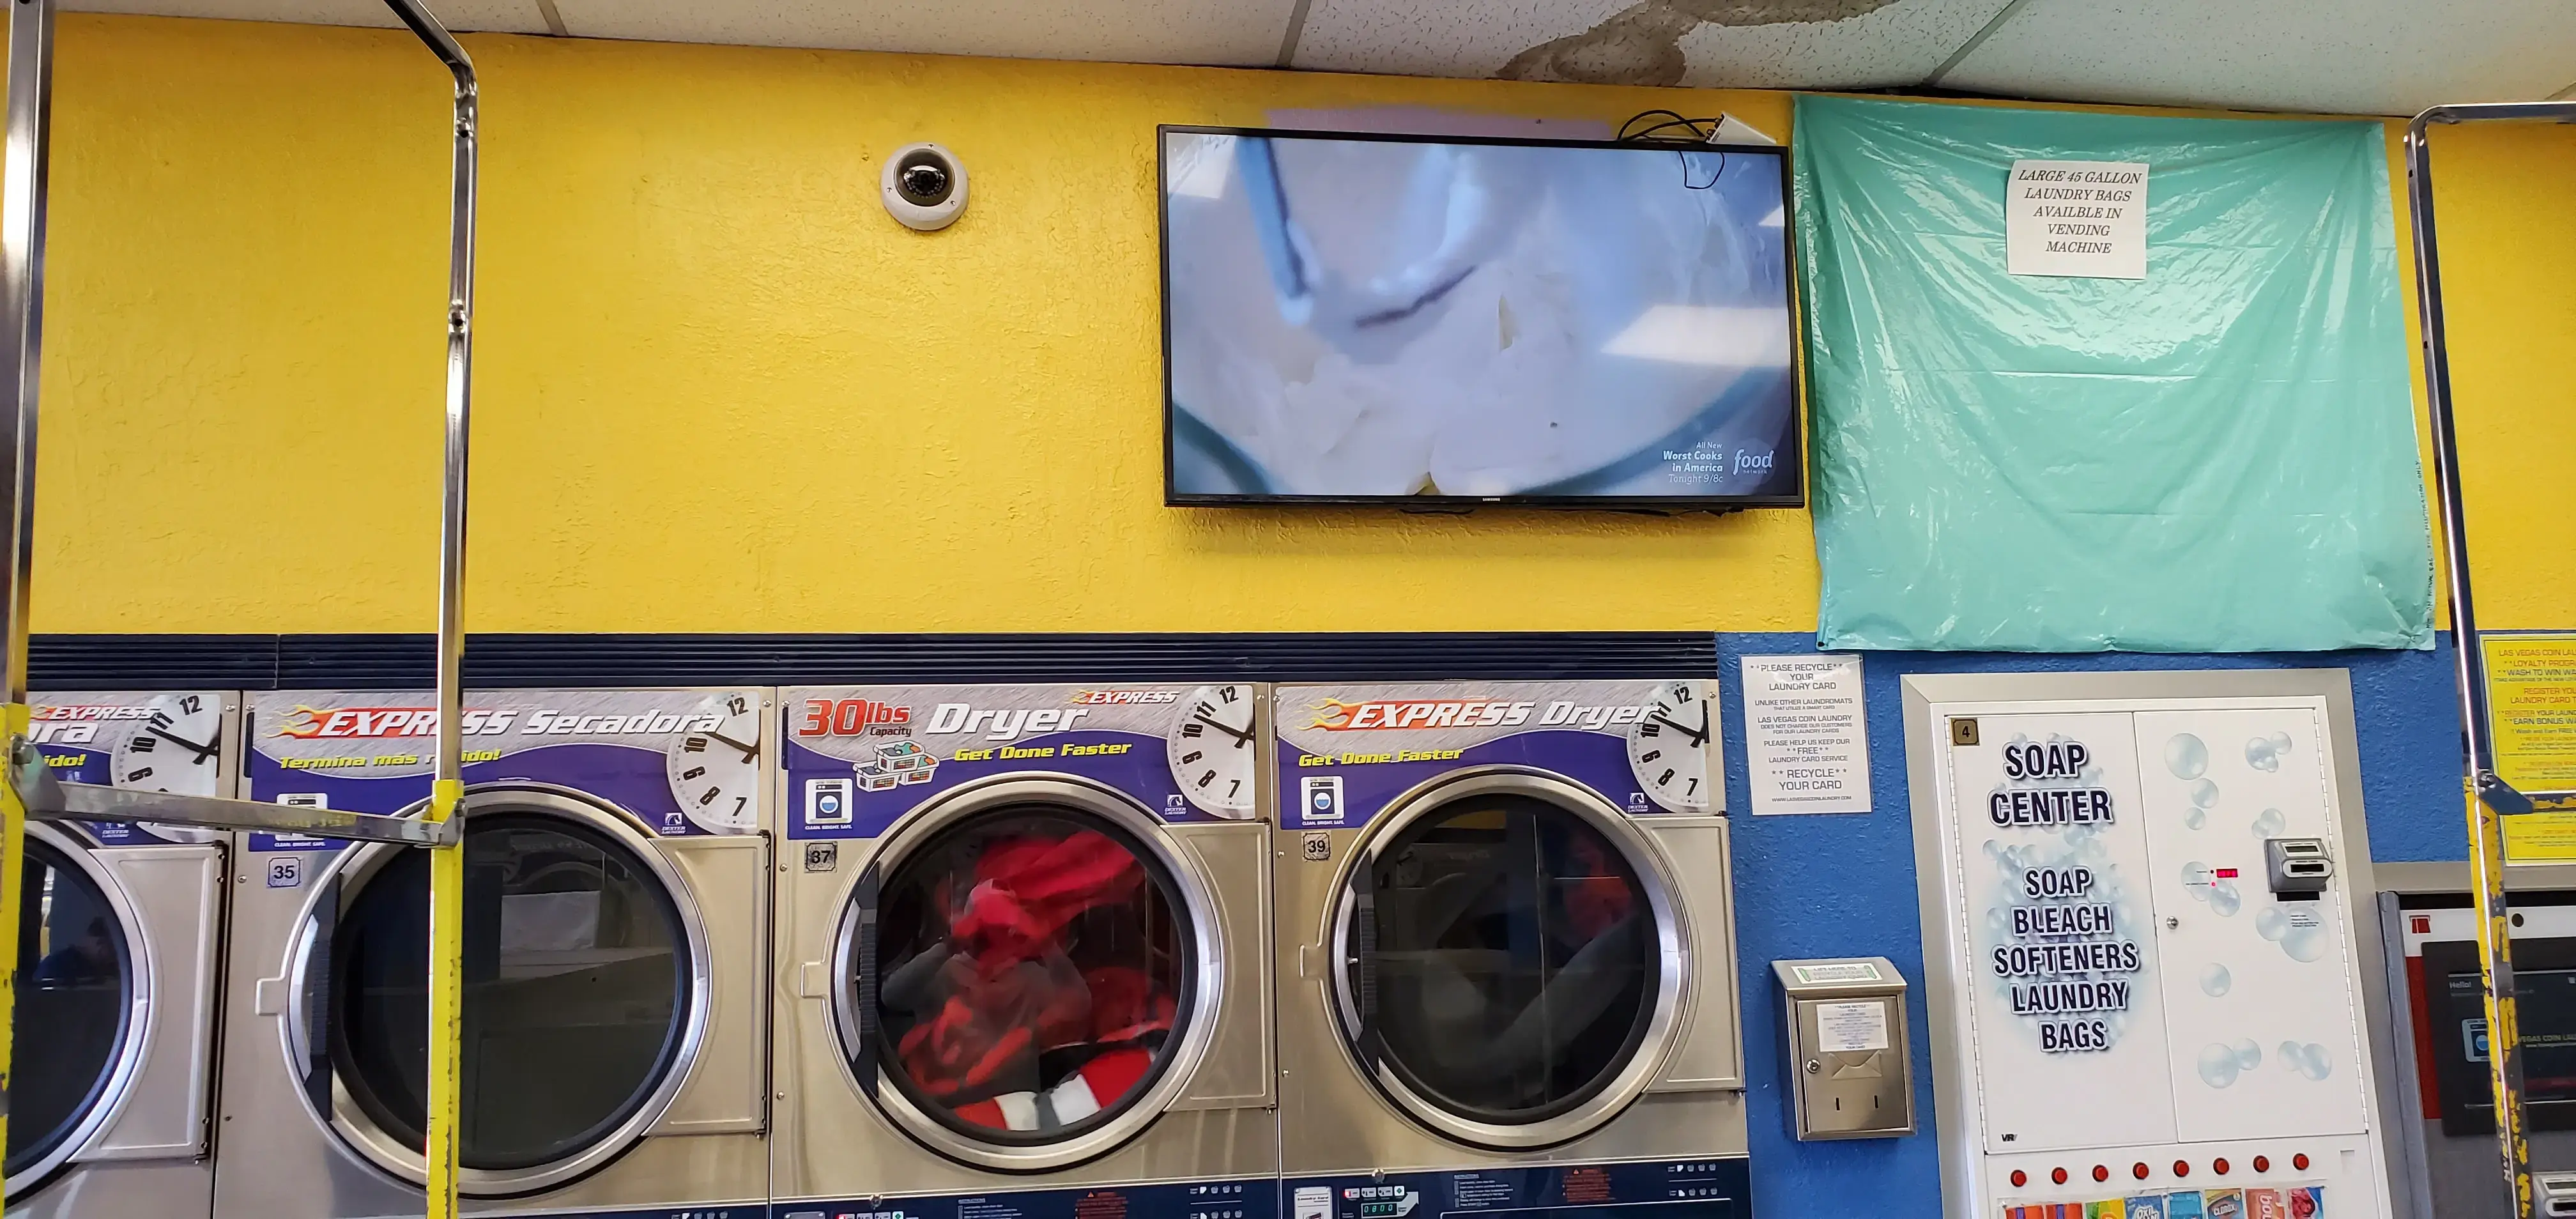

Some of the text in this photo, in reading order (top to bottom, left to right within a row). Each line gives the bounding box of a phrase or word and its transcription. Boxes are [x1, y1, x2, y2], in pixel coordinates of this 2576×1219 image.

[2018, 169, 2143, 184] LARGE 45 GALLON
[2024, 187, 2132, 201] LAUNDRY BAGS
[2033, 206, 2123, 219] AVAILBLE IN
[2048, 224, 2110, 236] VENDING
[2045, 241, 2112, 254] MACHINE
[1663, 450, 1722, 460] Worst Cooks
[1733, 448, 1774, 475] food
[1673, 463, 1723, 472] in America
[1669, 473, 1722, 485] Tonight 9/8c
[1091, 691, 1180, 704] EXPRESS
[1219, 686, 1239, 704] 12
[1674, 687, 1692, 704] 12
[49, 706, 161, 720] EXPRESS
[179, 695, 203, 716] 12
[726, 697, 748, 717] 12
[1197, 701, 1216, 717] 11
[150, 712, 174, 730] 11
[318, 709, 724, 736] EXPRSS Secadora
[926, 703, 1088, 740] Dryer
[1347, 701, 1661, 730] EXPRESS Dryer
[870, 727, 912, 737] Capacity
[1182, 723, 1203, 738] 10
[1641, 723, 1660, 738] 10
[1961, 726, 1970, 737] 4
[130, 737, 156, 753] 10
[684, 737, 707, 753] 10
[954, 743, 1132, 762] Get Done Faster
[280, 756, 367, 769] Termina
[373, 752, 417, 765] más
[1182, 750, 1202, 764] 9
[1298, 749, 1464, 767] Get Done Faster
[1641, 749, 1660, 763] 9
[2004, 743, 2086, 777] SOAP
[128, 767, 153, 783] 9
[683, 766, 705, 780] 9
[1197, 769, 1216, 788] 8
[1658, 768, 1675, 786] 8
[1228, 779, 1241, 798] 7
[1687, 778, 1698, 796] 7
[1779, 781, 1842, 790] YOUR CARD
[700, 786, 721, 805] 8
[732, 797, 747, 816] 7
[1989, 790, 2112, 825] CENTER
[1308, 839, 1326, 853] 39
[811, 850, 832, 864] 37
[273, 865, 295, 878] 35
[2025, 868, 2090, 896] SOAP
[2012, 905, 2111, 935] BLEACH
[1993, 942, 2138, 974] SOFTENERS
[2011, 981, 2126, 1012] LAUNDRY
[2041, 1022, 2106, 1050] BAGS
